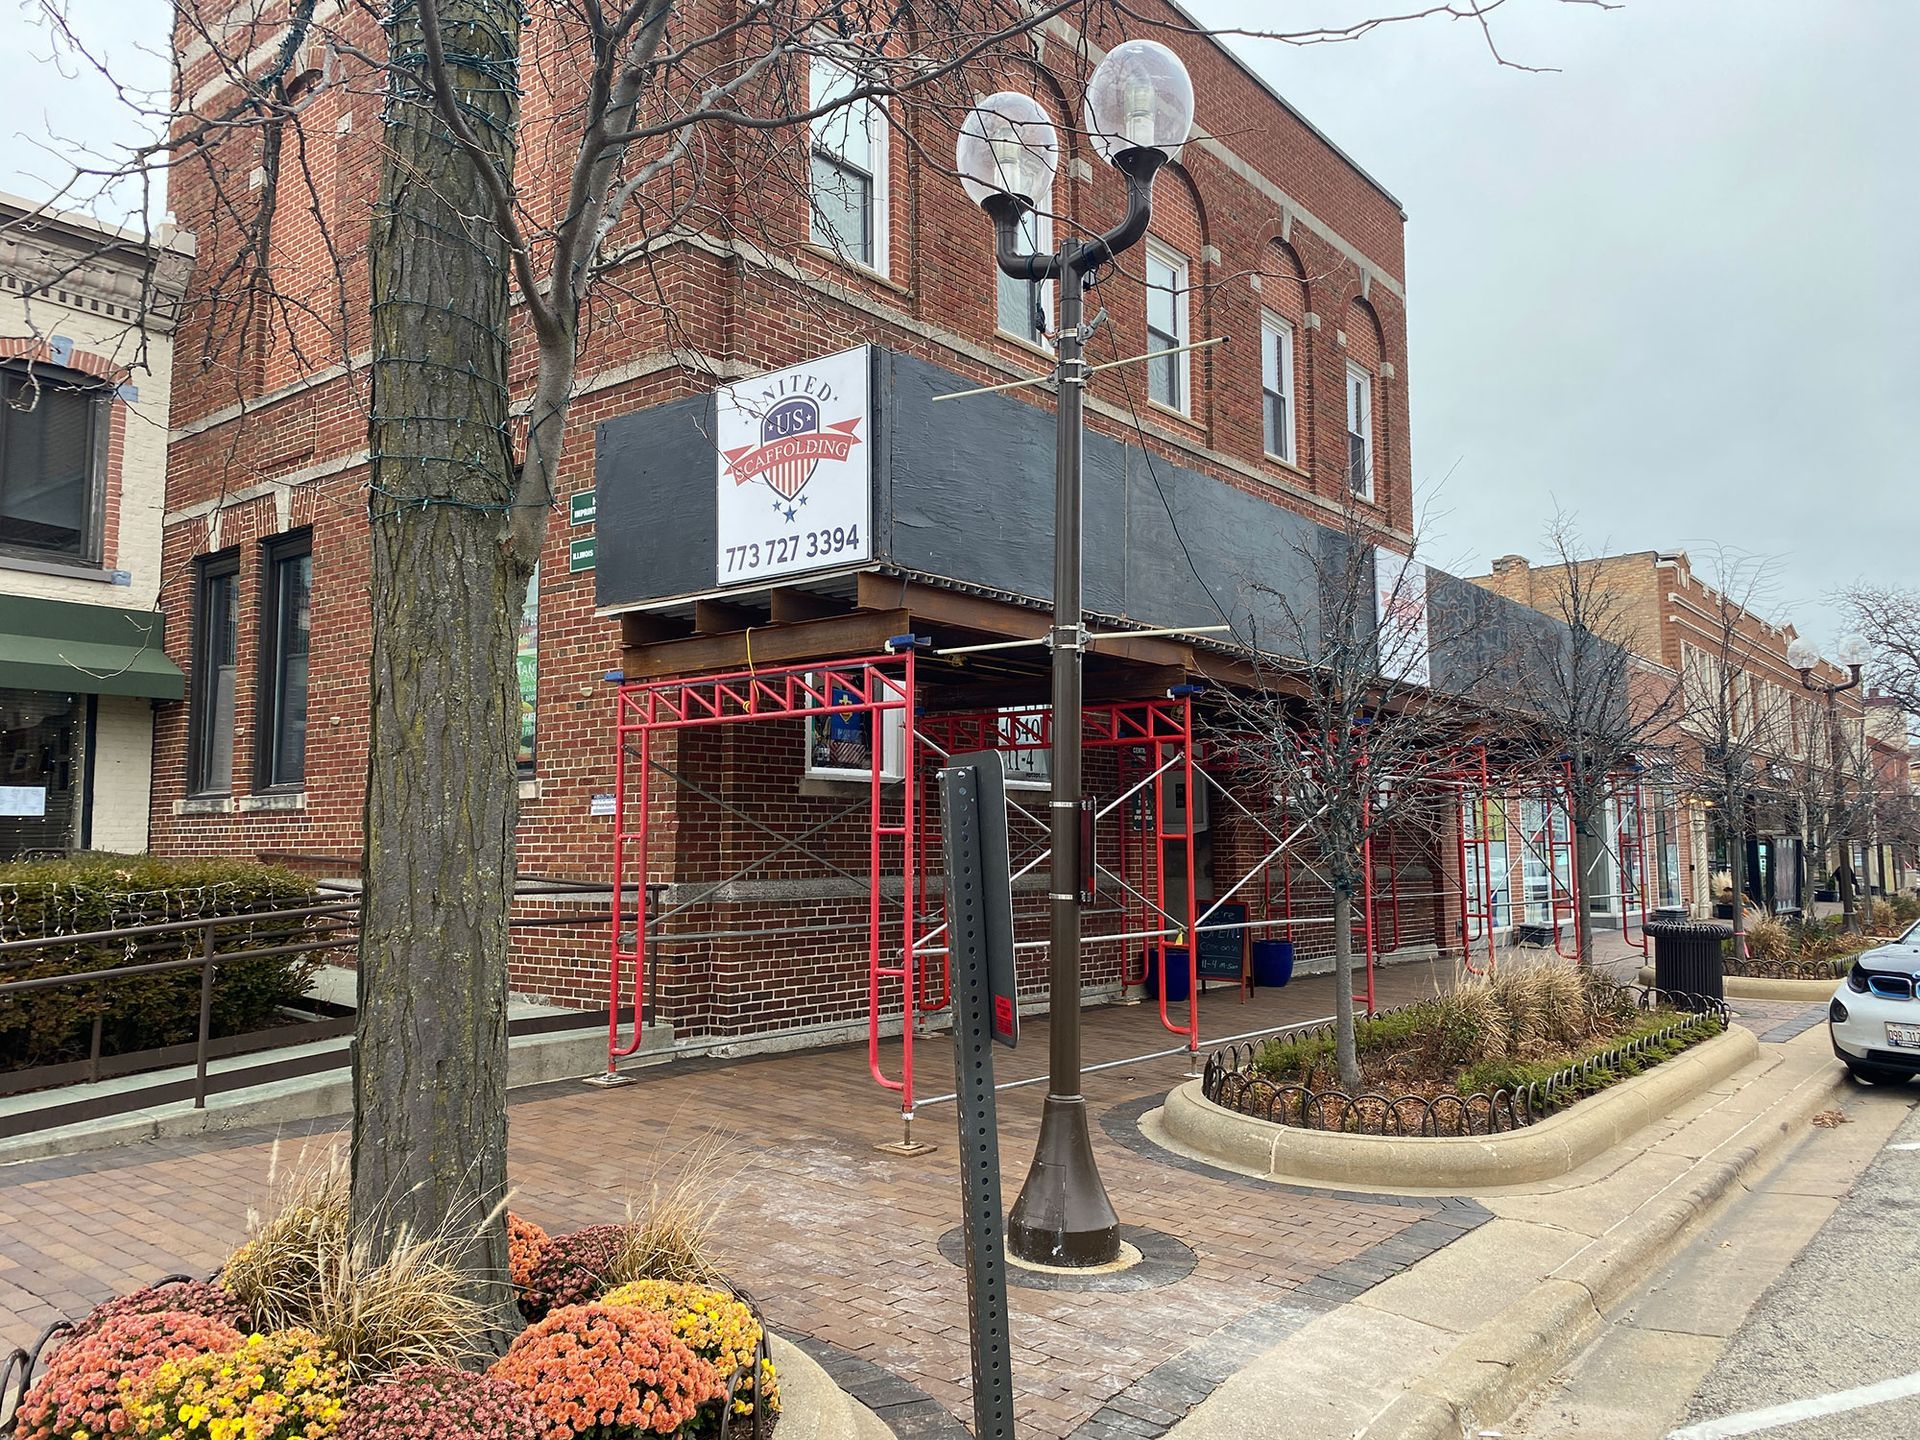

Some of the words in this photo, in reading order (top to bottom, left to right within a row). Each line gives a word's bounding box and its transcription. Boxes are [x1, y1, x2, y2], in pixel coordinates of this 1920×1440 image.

[776, 409, 804, 435] US
[735, 439, 848, 481] SCAFFOLDING
[726, 543, 760, 573] 773
[765, 535, 800, 566] 727
[806, 524, 860, 558] 3394
